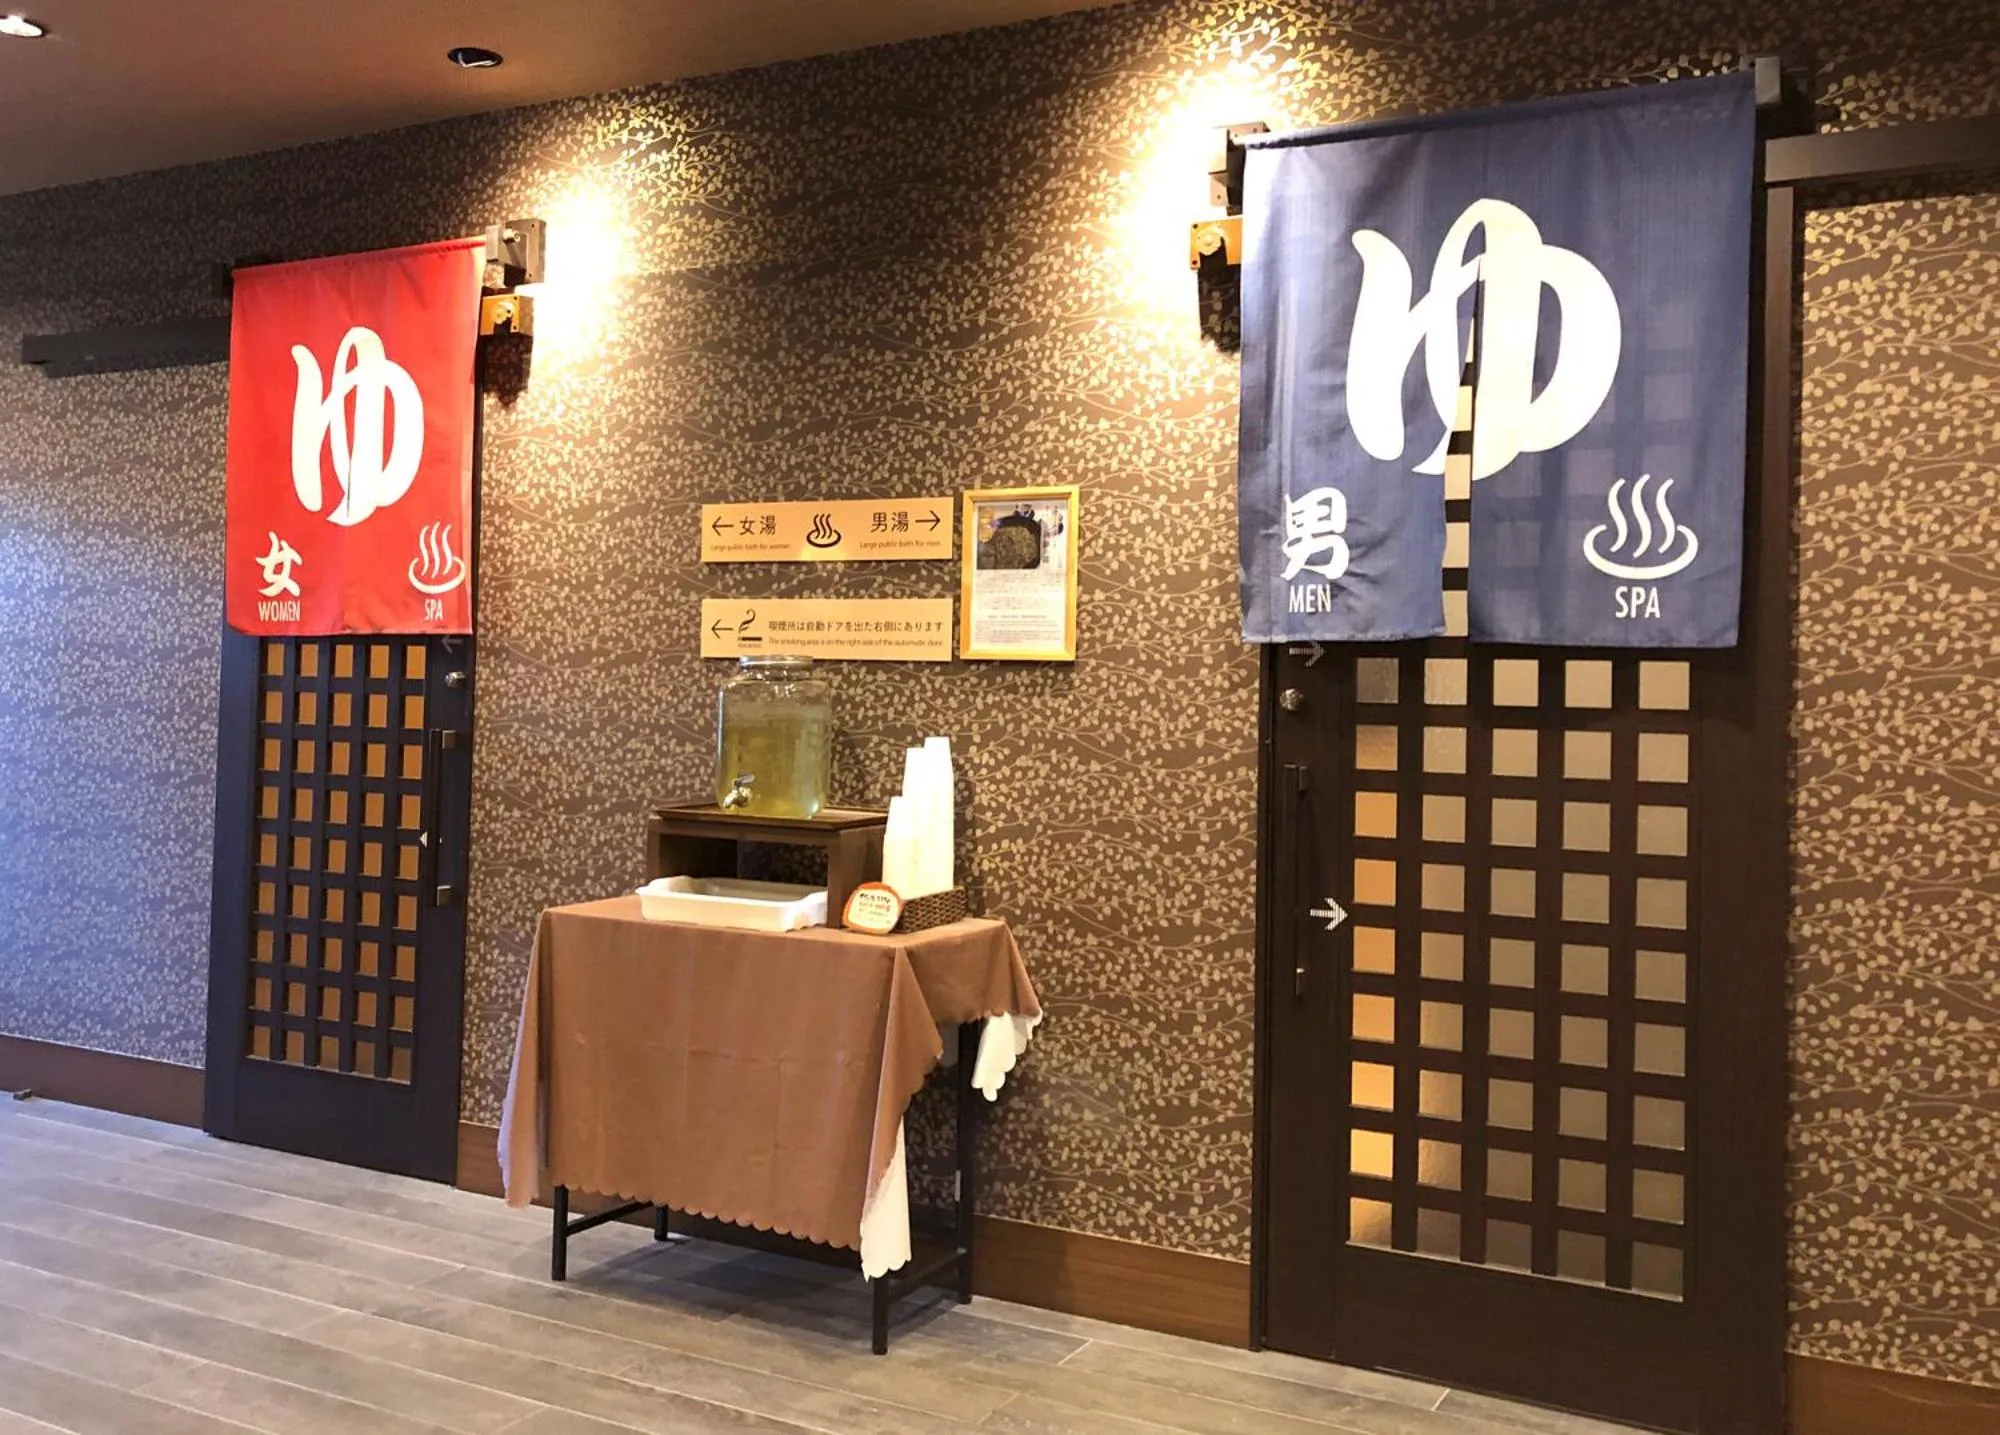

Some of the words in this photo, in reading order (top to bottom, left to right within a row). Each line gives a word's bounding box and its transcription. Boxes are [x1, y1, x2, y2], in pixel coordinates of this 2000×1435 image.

[1346, 198, 1621, 481] ゆ
[291, 326, 424, 526] ゆ
[739, 516, 776, 535] 女湯
[870, 511, 909, 533] 男湯
[1280, 486, 1350, 581] 男
[256, 531, 302, 597] 女
[258, 600, 301, 623] WOMEN
[424, 601, 444, 621] SPA
[1288, 583, 1332, 614] MEN
[1615, 585, 1661, 619] SPA
